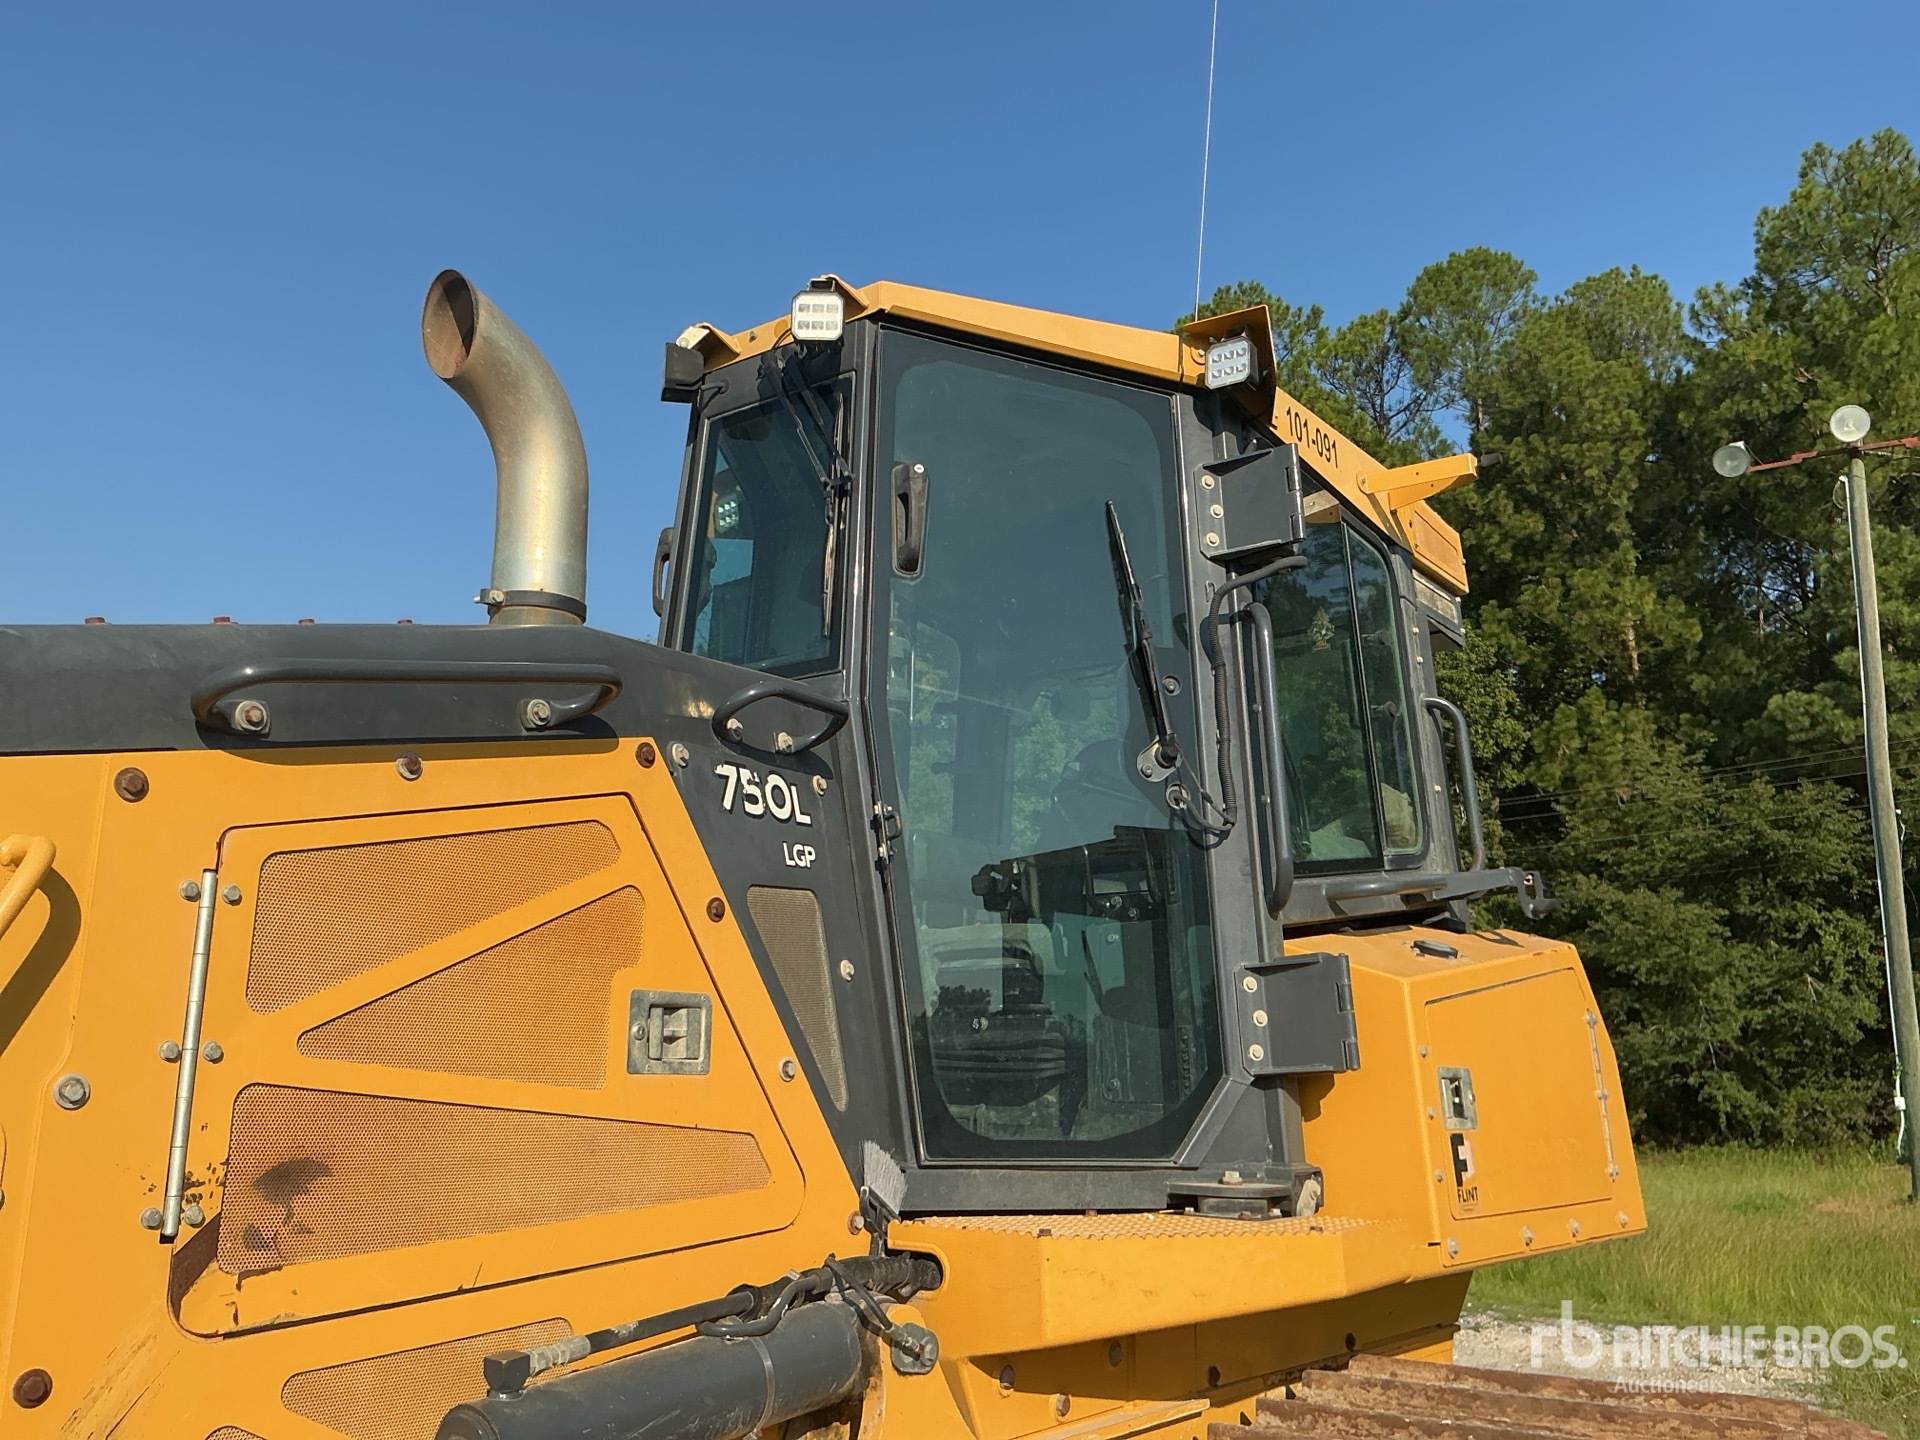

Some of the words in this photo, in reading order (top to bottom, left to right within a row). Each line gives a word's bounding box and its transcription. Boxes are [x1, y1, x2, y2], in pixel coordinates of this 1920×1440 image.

[1286, 406, 1338, 469] 101-091
[714, 764, 811, 824] 750L
[783, 842, 816, 868] LGP
[1457, 1186, 1479, 1203] FLINT
